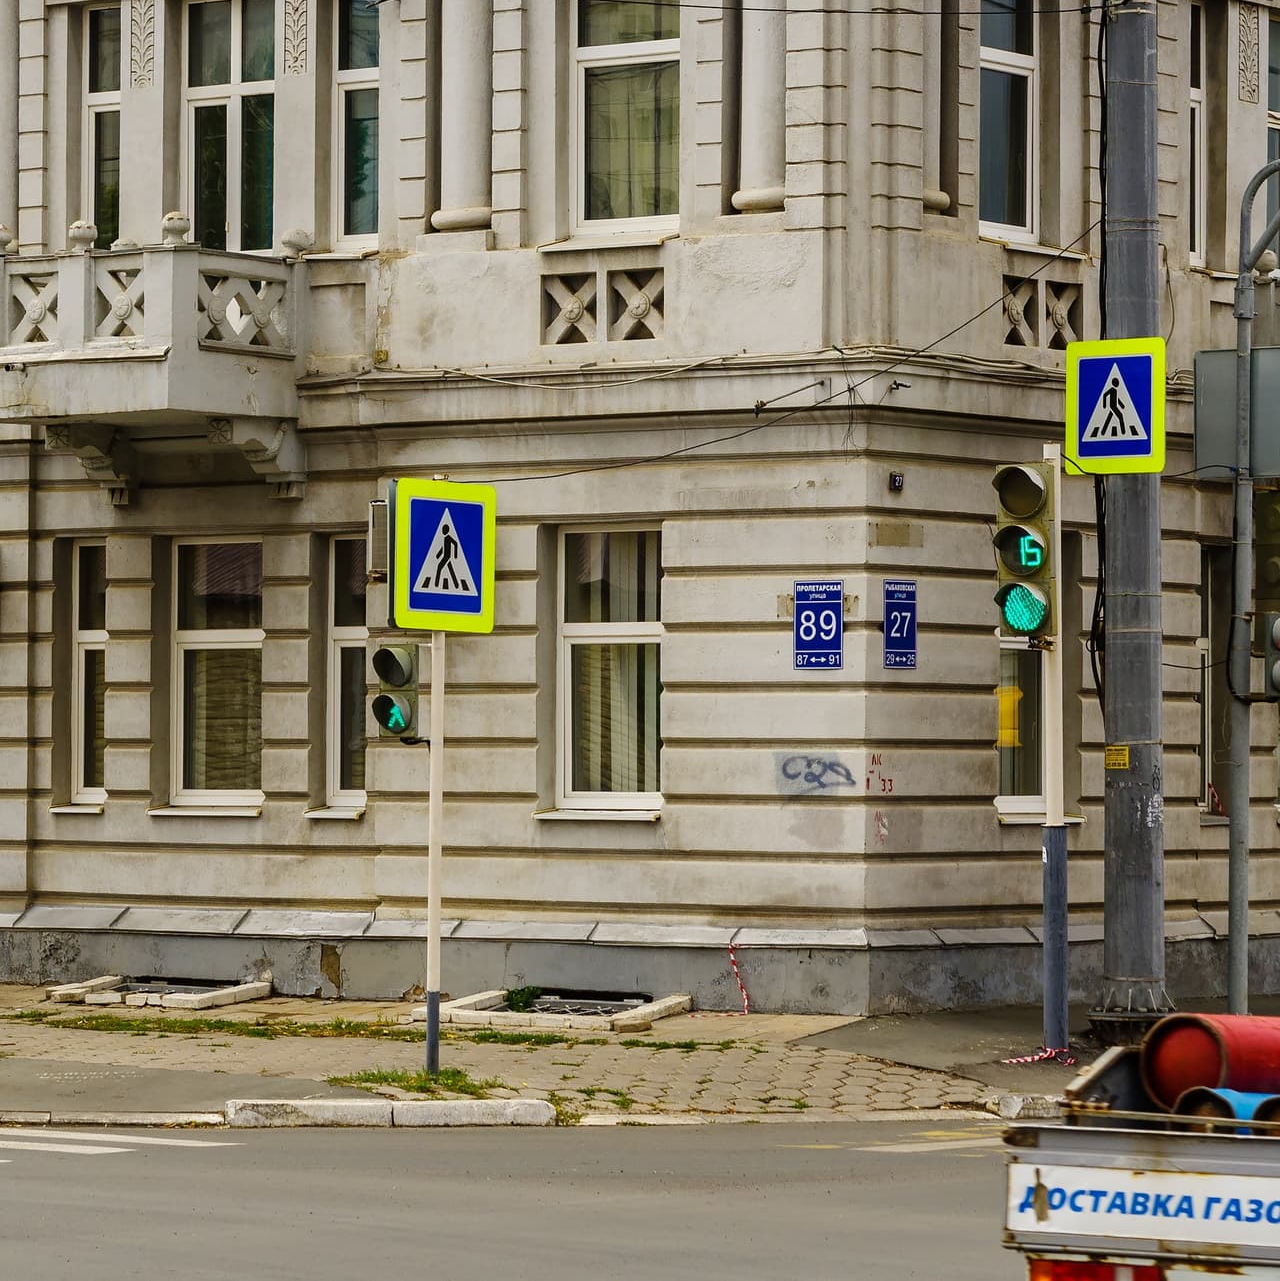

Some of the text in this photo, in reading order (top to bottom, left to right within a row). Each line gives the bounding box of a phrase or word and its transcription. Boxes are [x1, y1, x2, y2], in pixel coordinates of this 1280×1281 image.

[1020, 536, 1041, 566] 15
[796, 584, 841, 592] ПРОЛЕТАРСКАЯ
[799, 609, 837, 641] 89
[890, 611, 911, 638] 27
[797, 654, 840, 665] 87 91
[886, 653, 915, 665] 29 25
